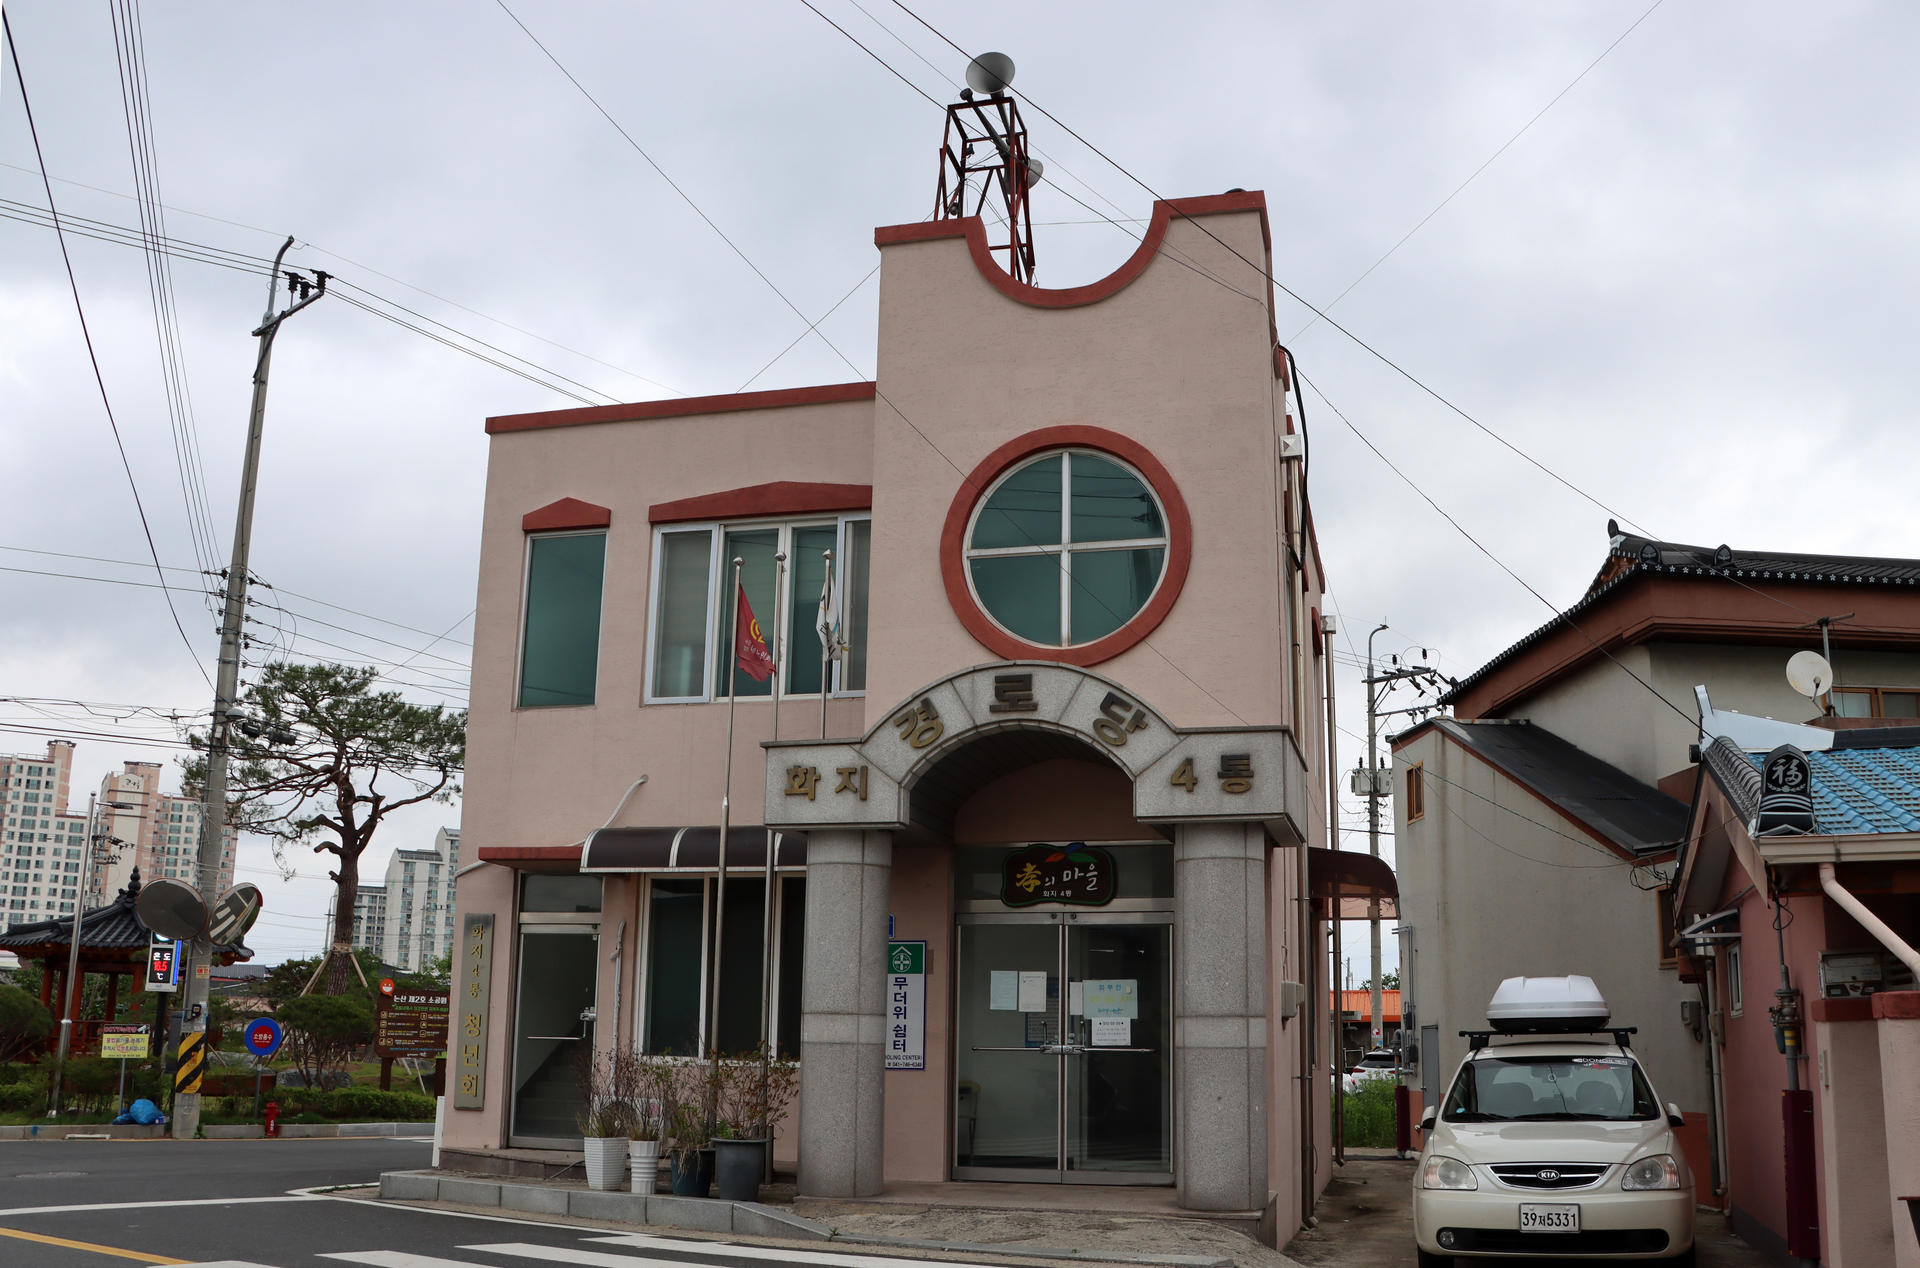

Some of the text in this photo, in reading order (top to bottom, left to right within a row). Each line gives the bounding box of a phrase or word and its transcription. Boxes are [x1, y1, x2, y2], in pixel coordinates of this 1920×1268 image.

[893, 674, 1148, 748] 경로당
[784, 753, 1254, 801] 화지 4통
[893, 976, 908, 1053] 무더위 쉼터
[460, 1012, 482, 1097] 청년회
